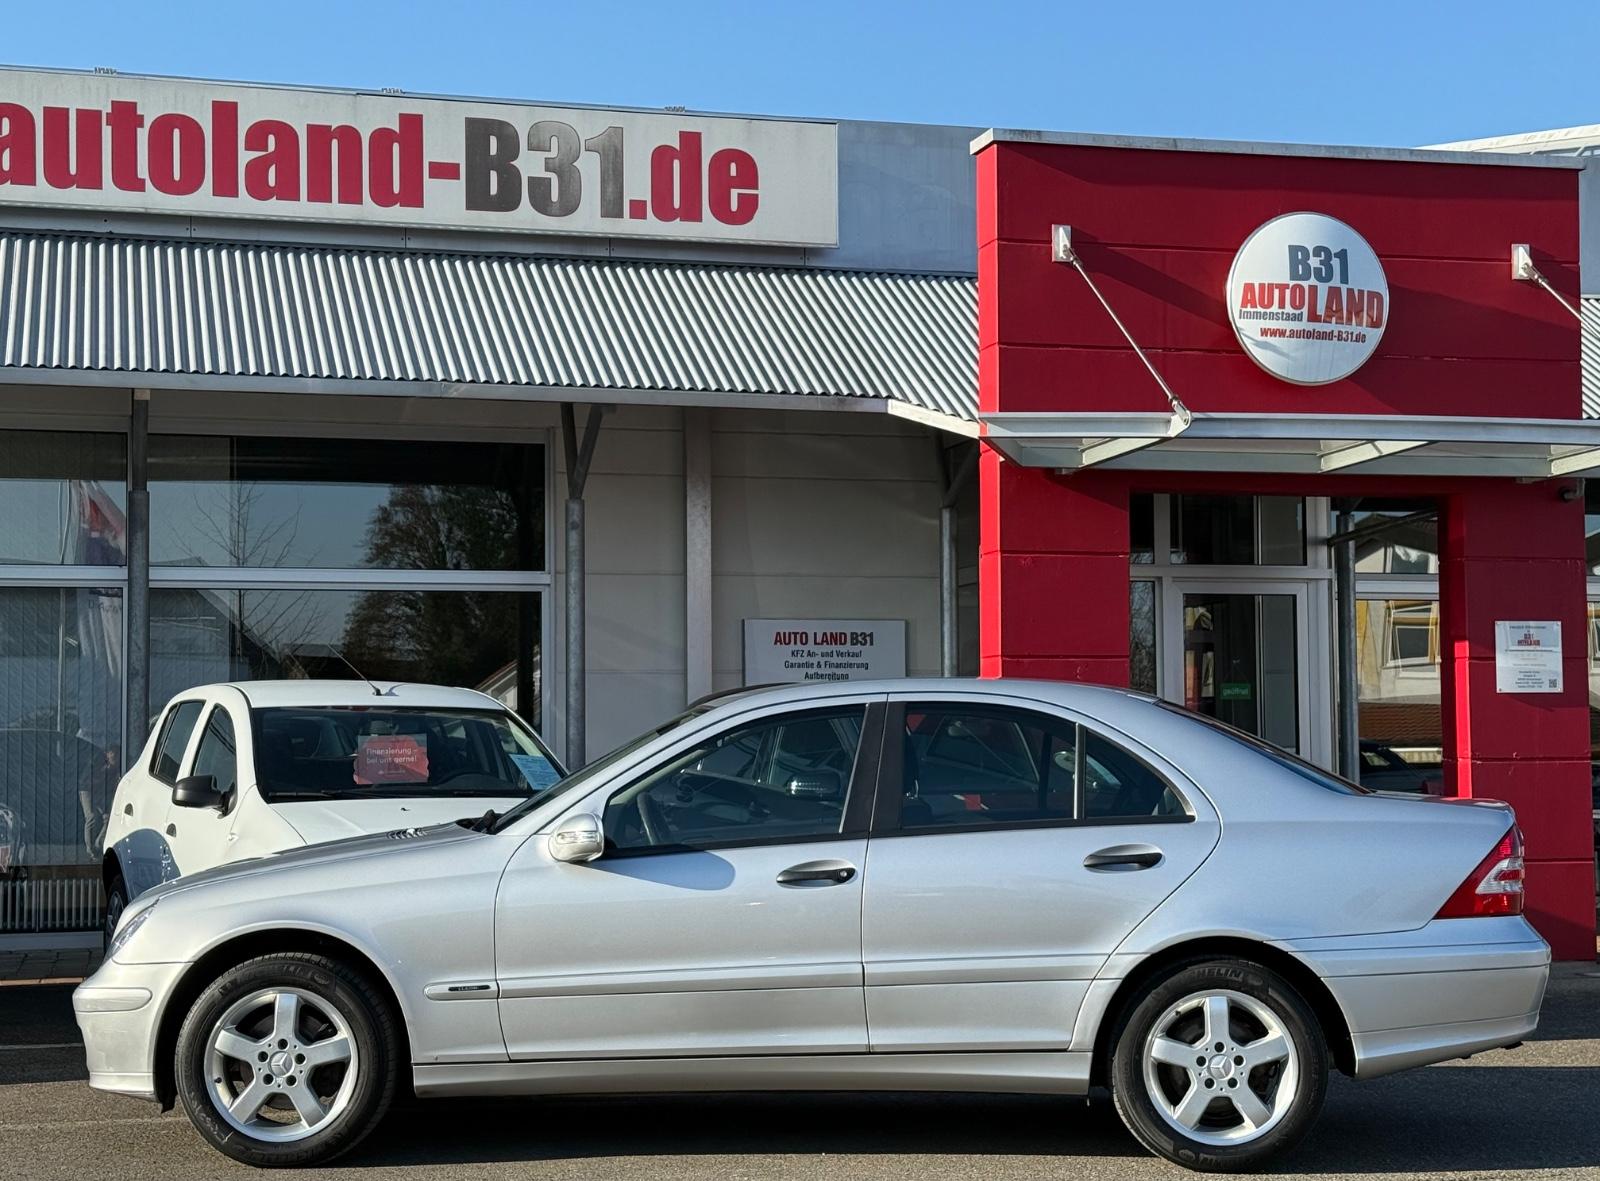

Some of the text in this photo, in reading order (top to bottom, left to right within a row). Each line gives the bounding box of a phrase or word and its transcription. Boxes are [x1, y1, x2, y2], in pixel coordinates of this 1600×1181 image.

[0, 100, 759, 226] autoland-B31.de
[1288, 244, 1349, 285] B31
[1239, 309, 1304, 322] Immenstaad
[1260, 326, 1367, 343] www.autoland-B31.de
[774, 632, 874, 646] AUTO LAND B31
[791, 649, 862, 658] KFZ An- und Verkauf
[784, 660, 815, 669] Garantie
[824, 660, 869, 670] Finanzierung
